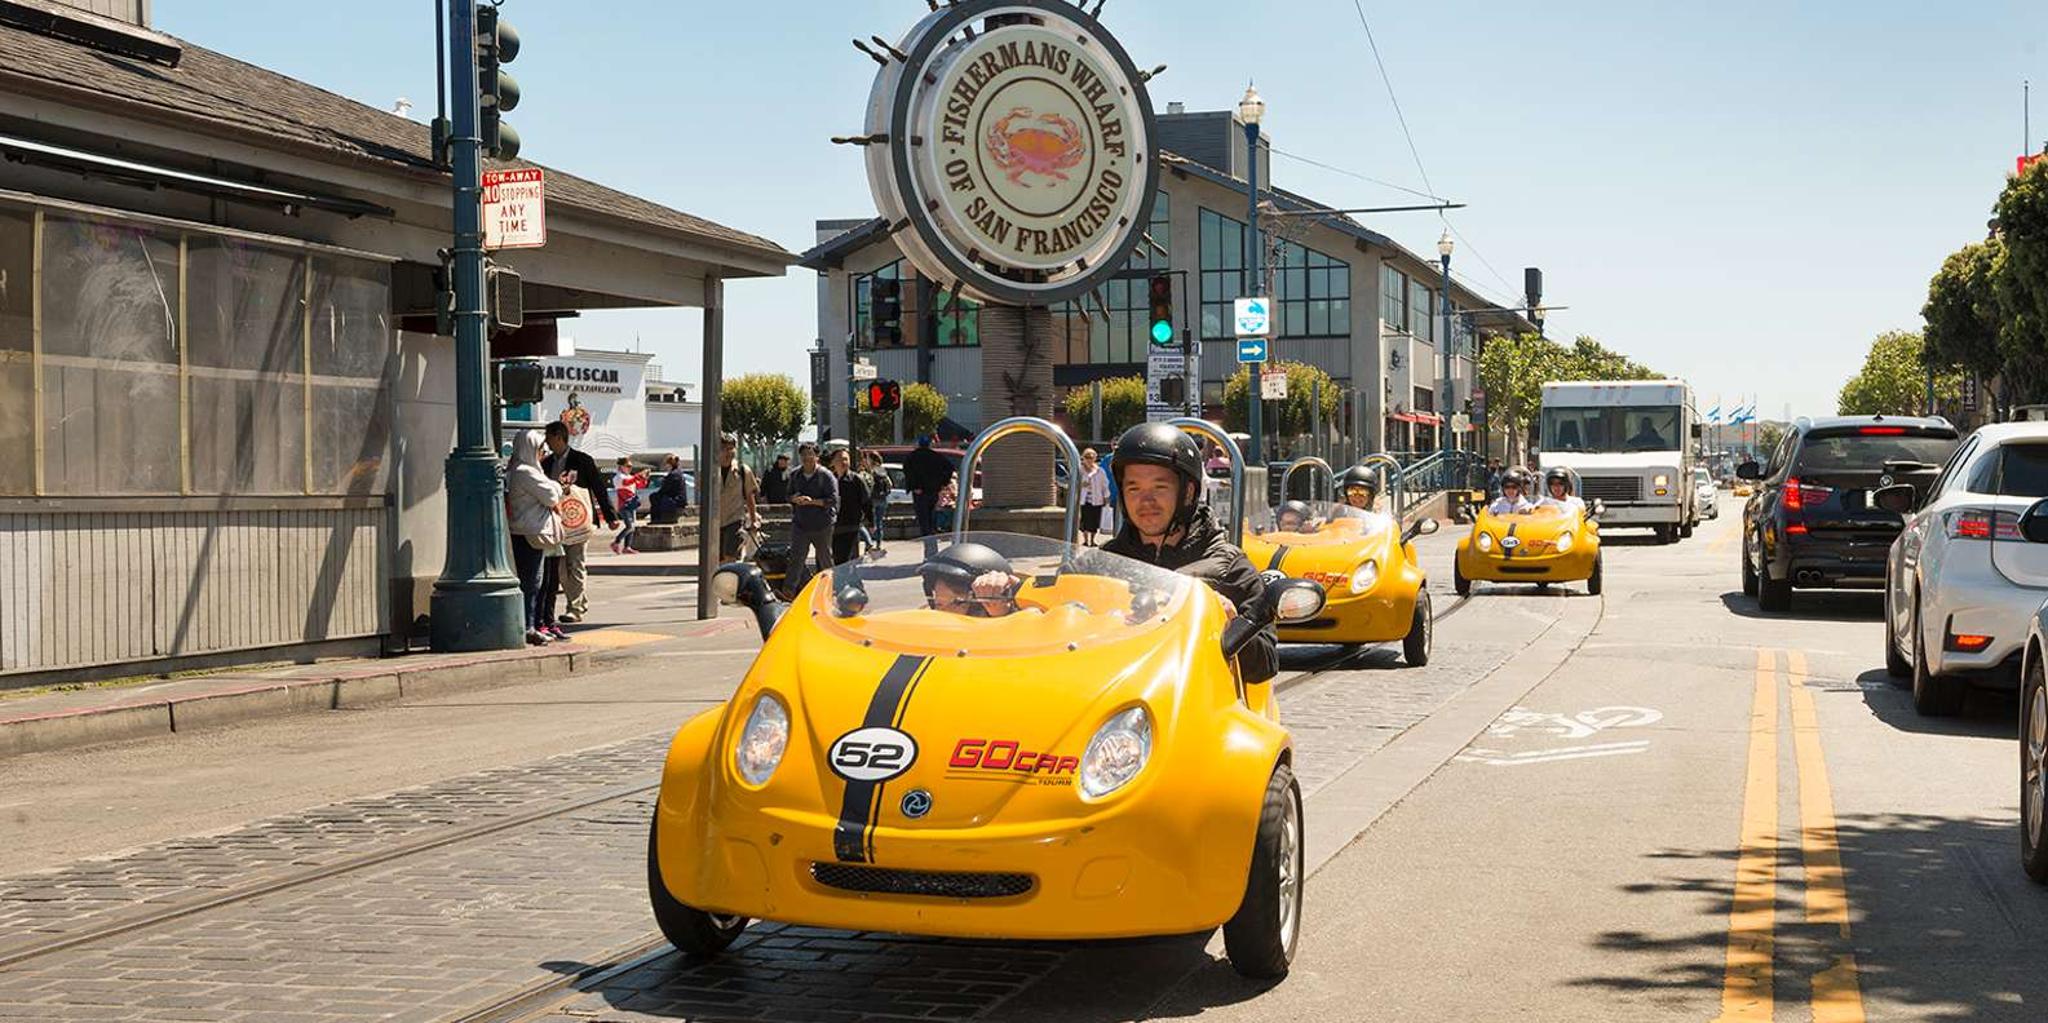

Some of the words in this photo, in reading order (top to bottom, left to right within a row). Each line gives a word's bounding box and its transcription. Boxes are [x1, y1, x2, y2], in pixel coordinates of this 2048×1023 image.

[942, 40, 1071, 146] FISHERMANS
[1068, 58, 1126, 159] WHARF
[486, 171, 538, 184] TOW-AWAY
[484, 185, 500, 203] NO
[501, 185, 539, 201] STOPPING
[501, 204, 526, 217] ANY
[945, 158, 976, 194] OF
[964, 199, 1013, 245] SAN
[1014, 168, 1123, 256] FRANCISCO
[499, 219, 528, 232] TIME
[836, 742, 905, 770] 52
[948, 738, 1080, 775] GOCAR
